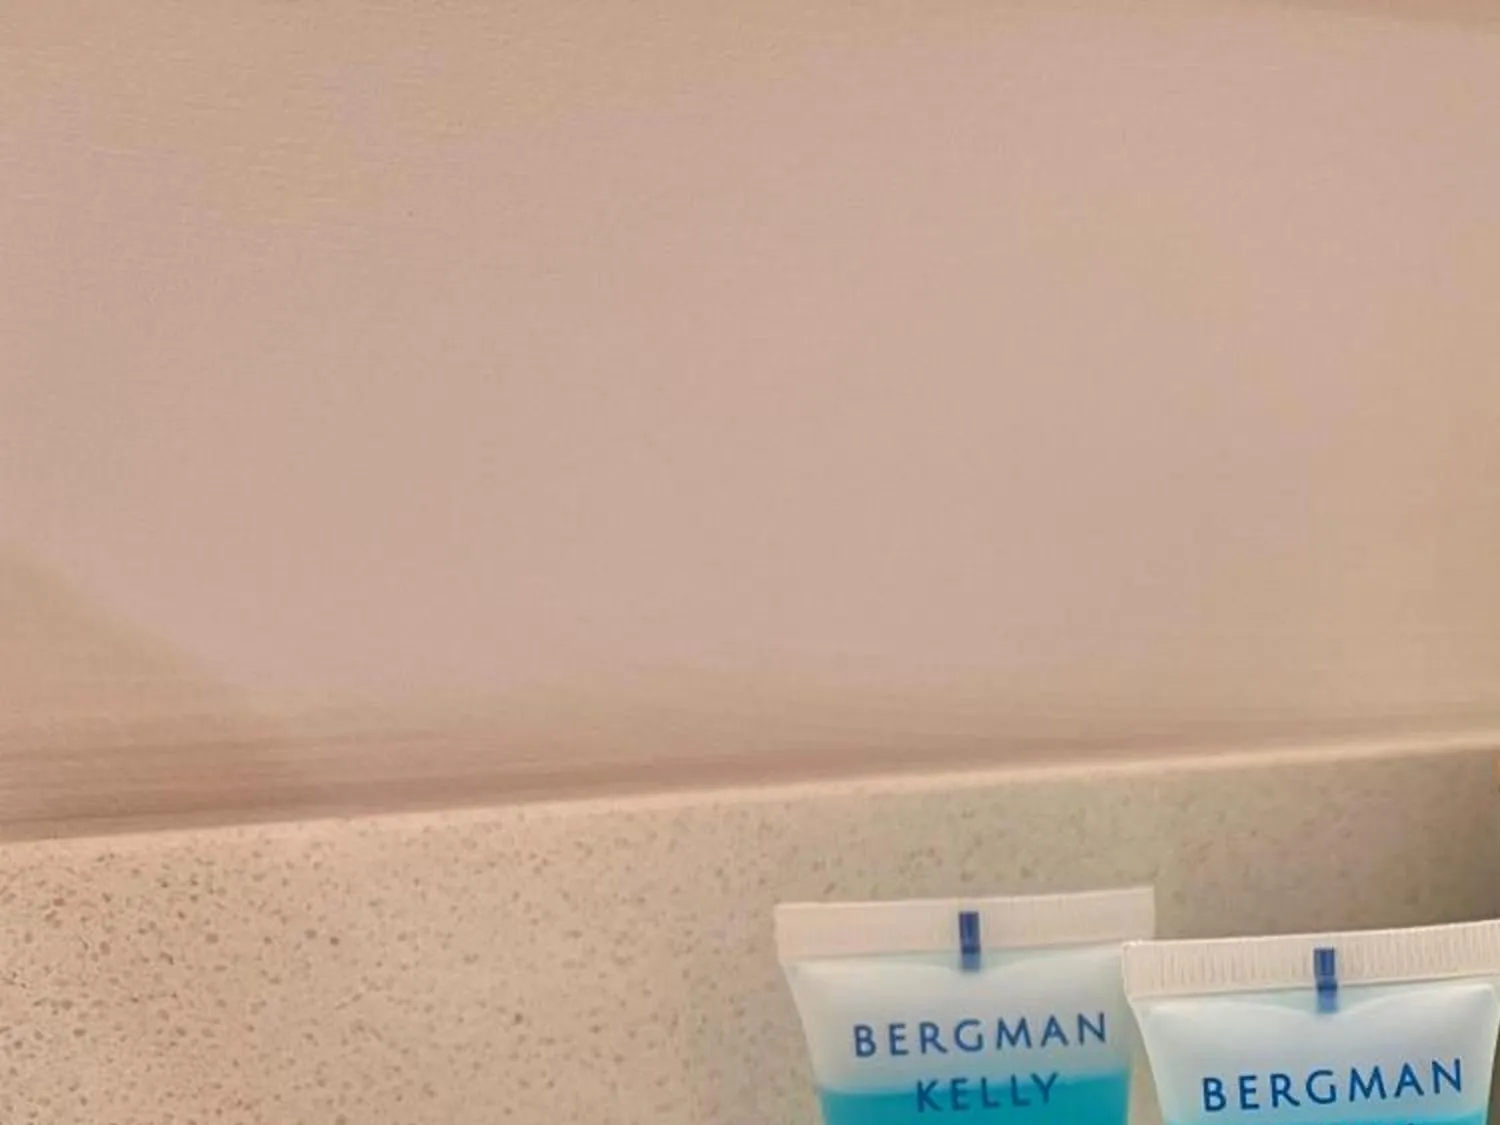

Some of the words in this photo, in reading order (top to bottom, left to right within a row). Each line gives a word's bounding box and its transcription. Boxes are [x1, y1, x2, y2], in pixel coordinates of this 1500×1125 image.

[854, 1011, 1106, 1058] BERGMAN
[916, 1072, 1059, 1113] KELLY
[1203, 1058, 1462, 1112] BERGMAN
